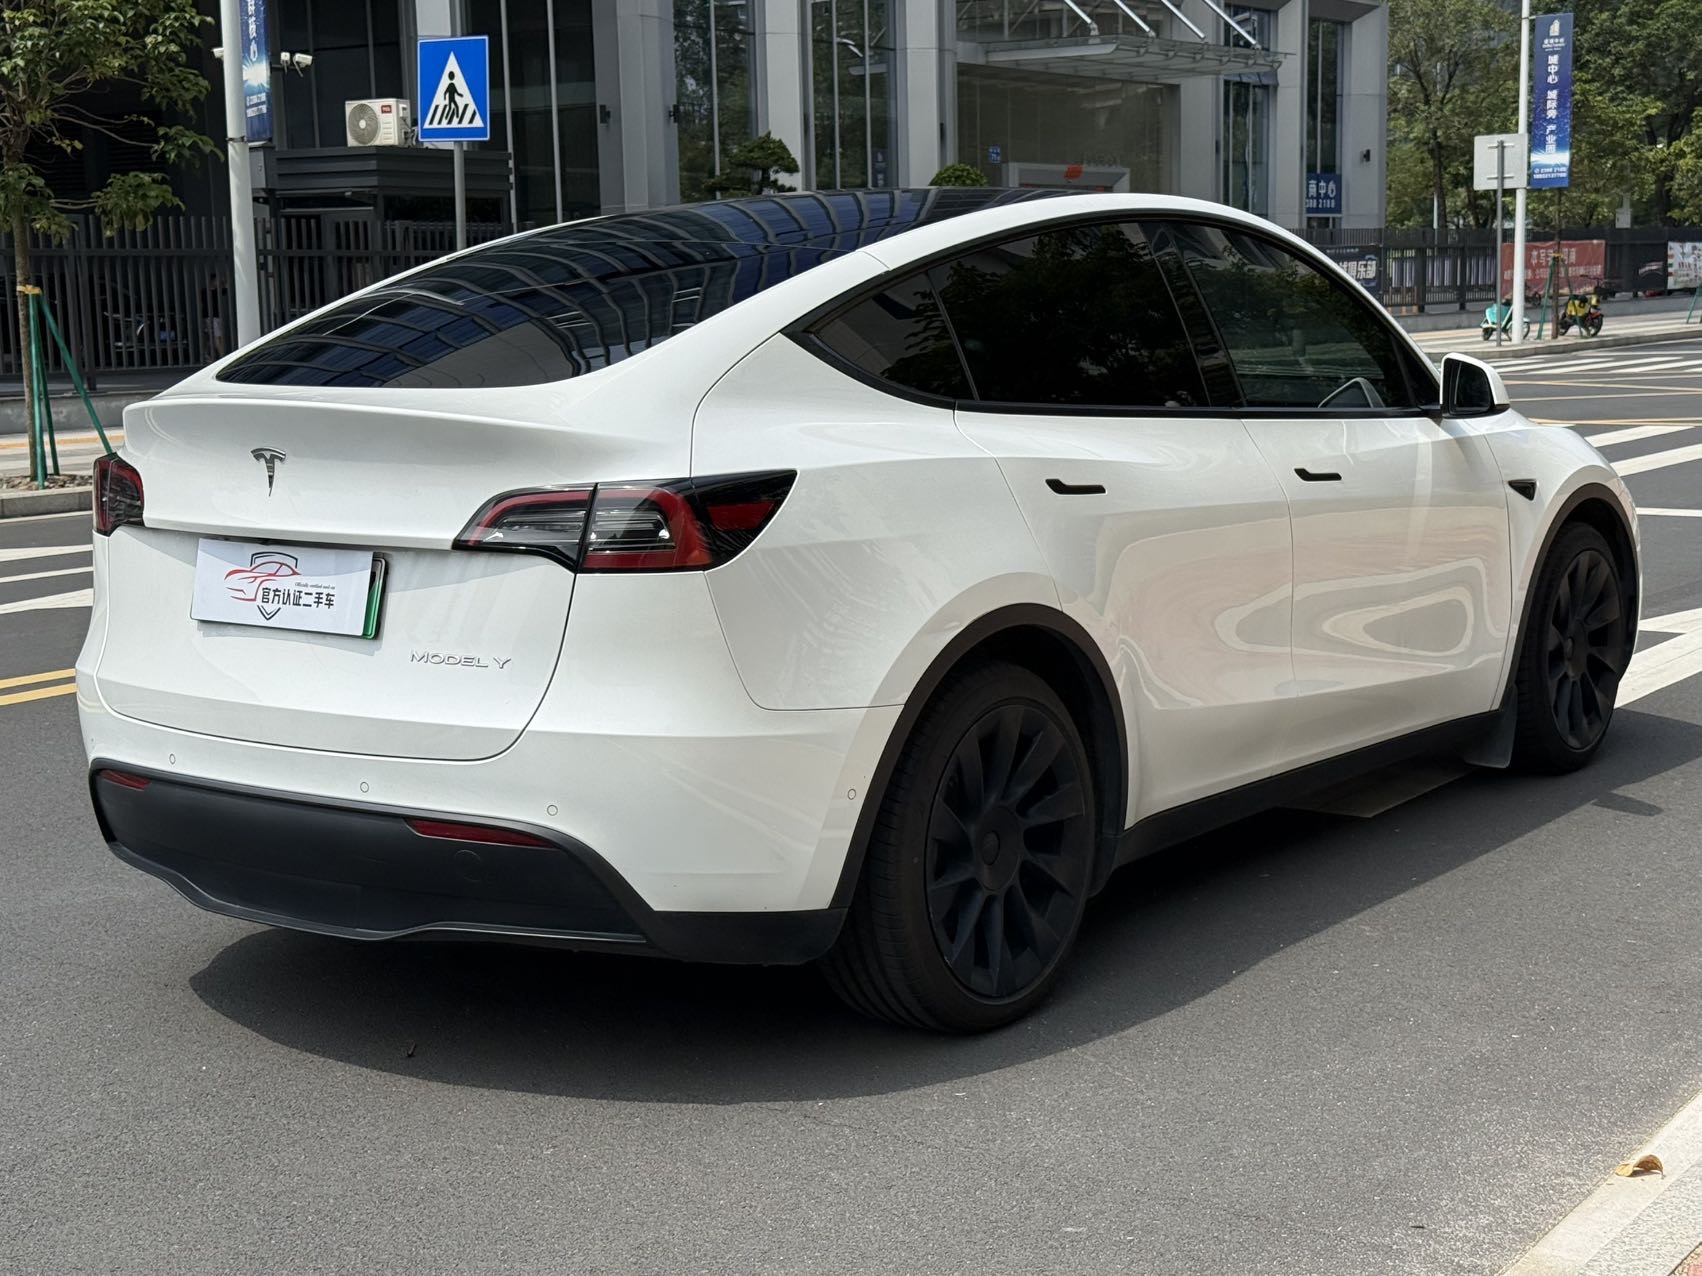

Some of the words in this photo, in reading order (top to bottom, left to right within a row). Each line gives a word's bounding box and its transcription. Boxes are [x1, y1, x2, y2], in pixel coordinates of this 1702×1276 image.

[262, 587, 335, 609] 官方认证二手车
[410, 650, 489, 668] MODEL
[493, 656, 511, 669] Y
